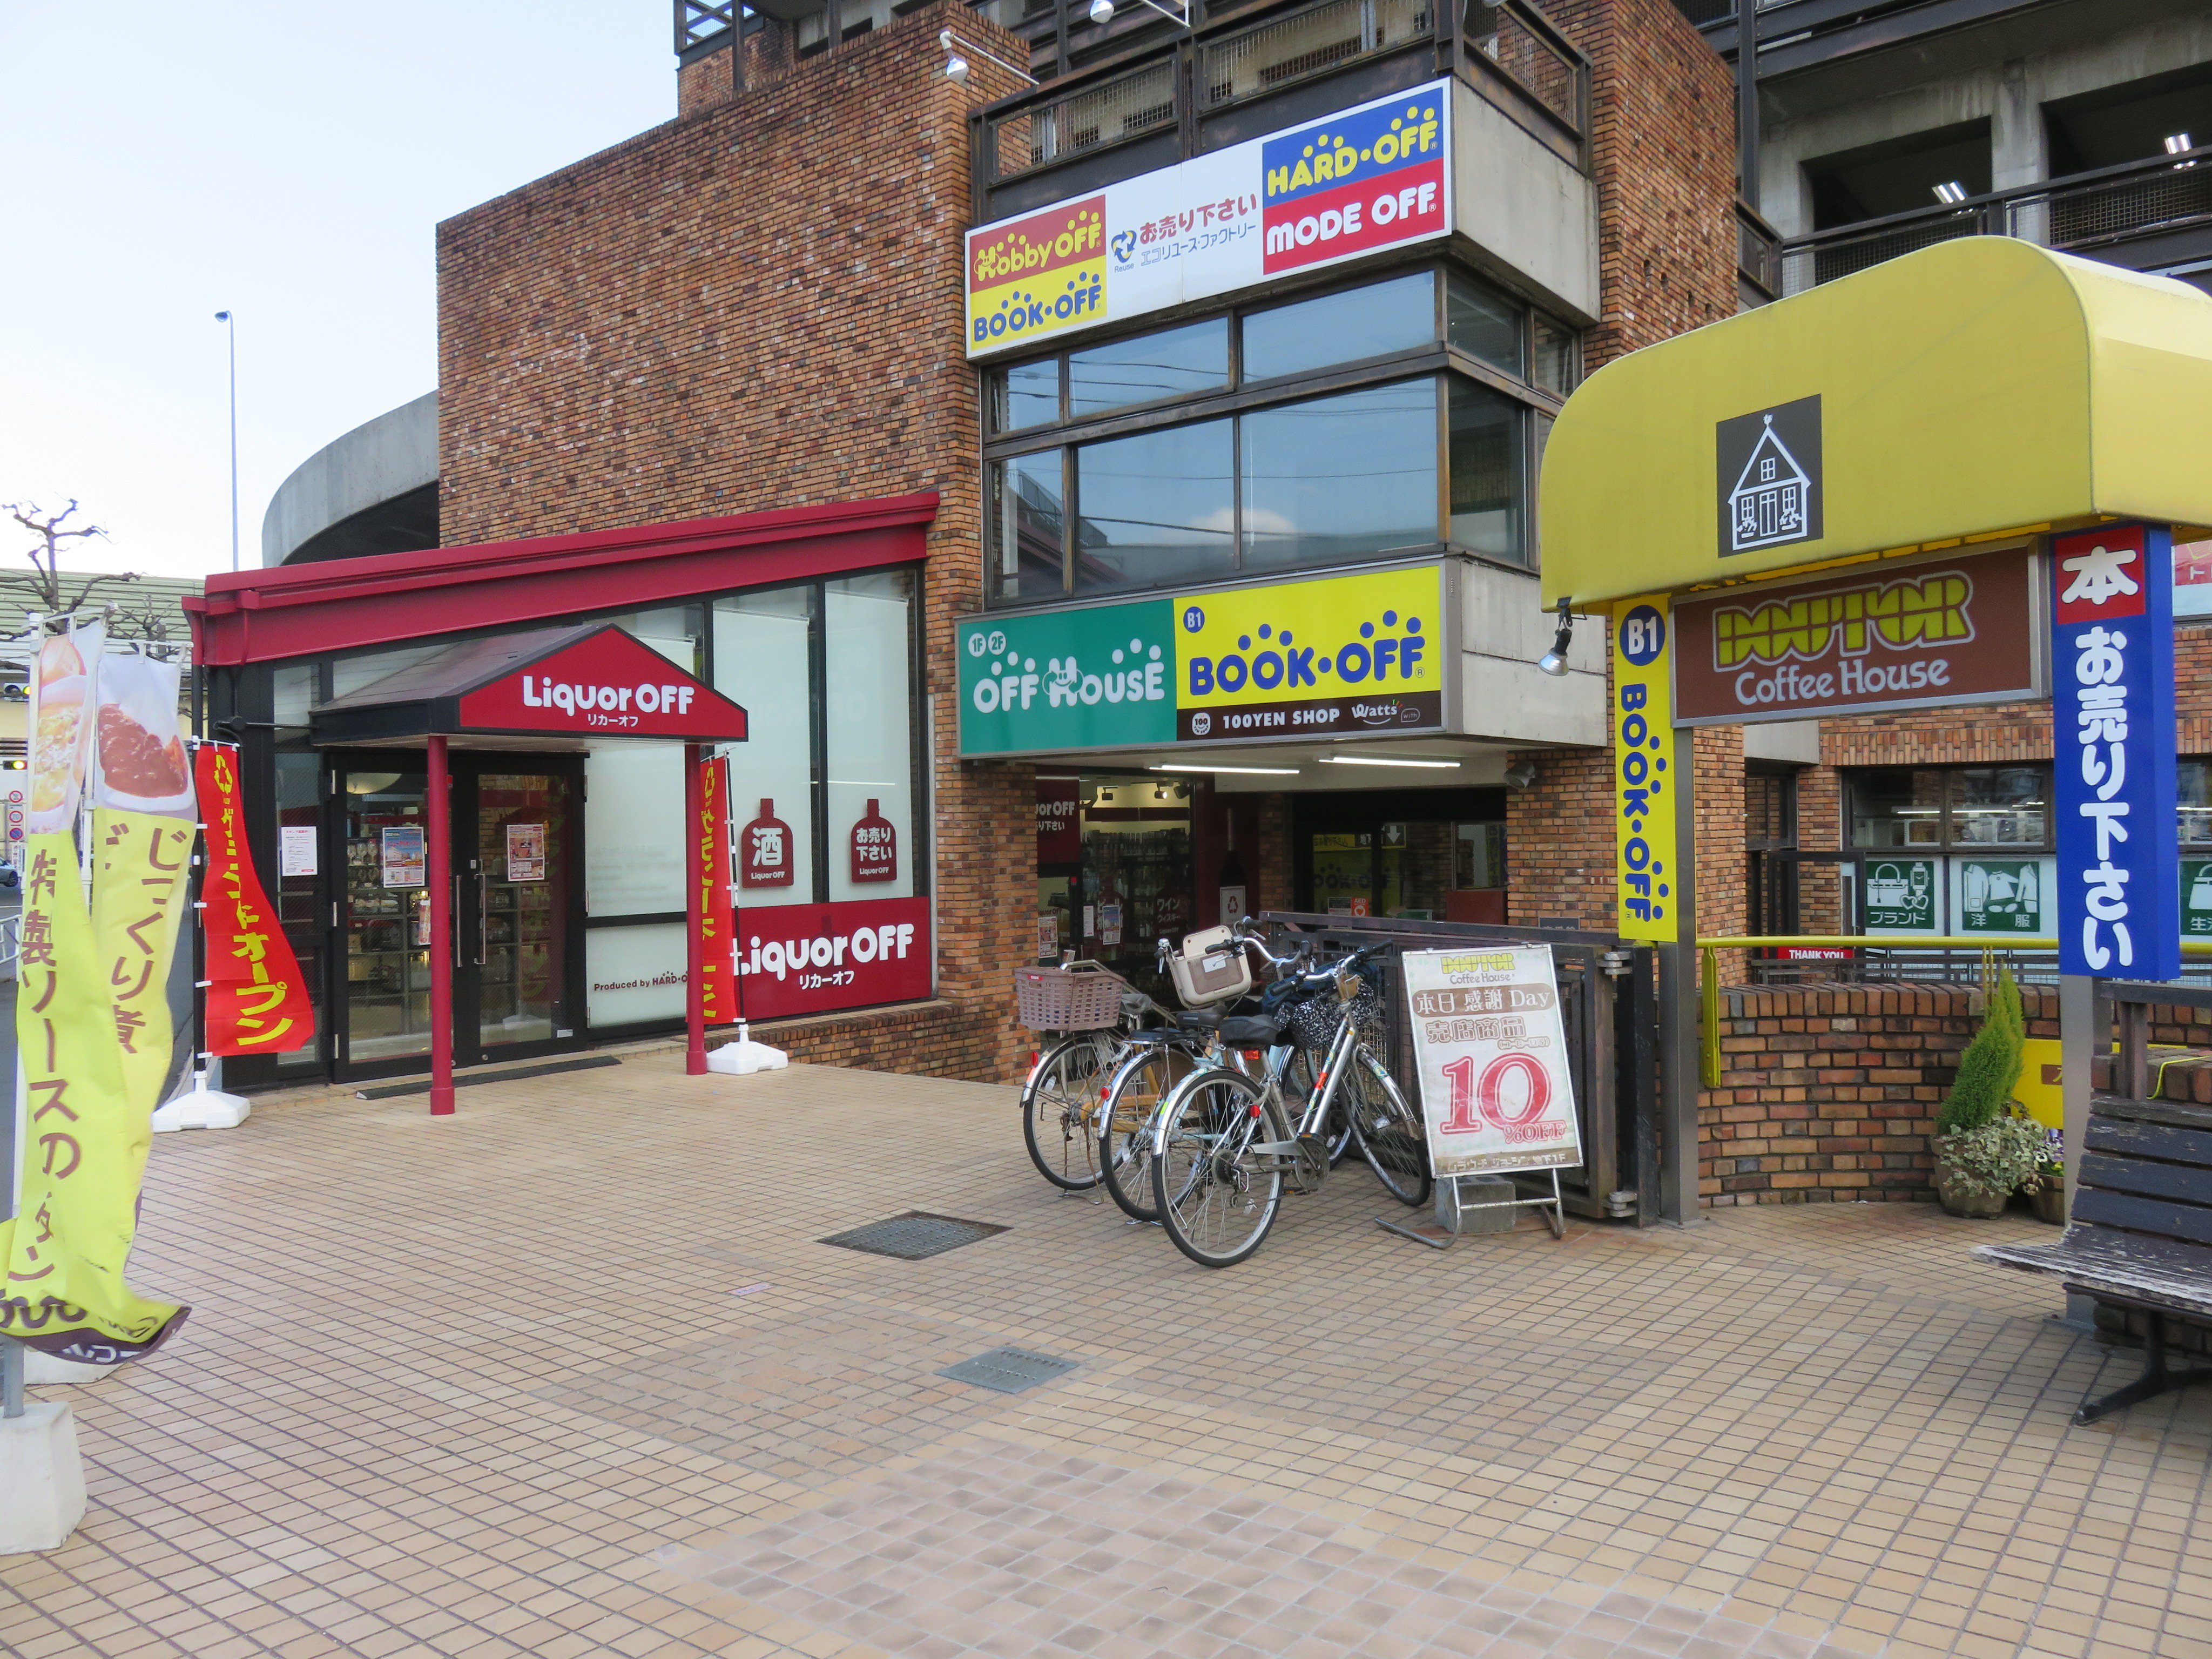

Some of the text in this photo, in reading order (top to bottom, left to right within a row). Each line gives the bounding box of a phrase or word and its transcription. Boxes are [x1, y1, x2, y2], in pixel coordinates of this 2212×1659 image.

[1140, 193, 1257, 244] お売り下さい
[1267, 182, 1437, 255] MODE OFF
[1114, 263, 1134, 273] Reuse
[2061, 545, 2139, 605] 本
[1187, 612, 1202, 628] B1
[1713, 570, 1975, 673] DOUTOR
[972, 635, 1004, 652] 1F 2F
[1627, 615, 1658, 655] B1
[973, 656, 1165, 713] OFF HOUSE
[1735, 658, 1950, 705] Coffee House
[588, 713, 639, 727] リカーオフ
[1223, 712, 1285, 729] 100YEN
[1292, 708, 1340, 725] SHOP
[2075, 625, 2133, 970] お売り下さい
[856, 827, 891, 843] お売り
[1036, 820, 1065, 831] り下さい
[752, 827, 783, 867] 酒
[856, 845, 892, 862] 下さい
[1871, 911, 1927, 926] ブランド
[1441, 953, 1515, 974] DOUTOR
[1789, 949, 1822, 959] THANK
[594, 980, 637, 992] Produced
[639, 979, 650, 988] by
[799, 970, 855, 990] リカーオフ
[1450, 973, 1510, 985] Coffee House
[1417, 989, 1551, 1015] 本日 感謝 Day
[1426, 1016, 1527, 1044] 売店商品
[1440, 1052, 1552, 1135] 10
[1502, 1120, 1566, 1144] %OFF
